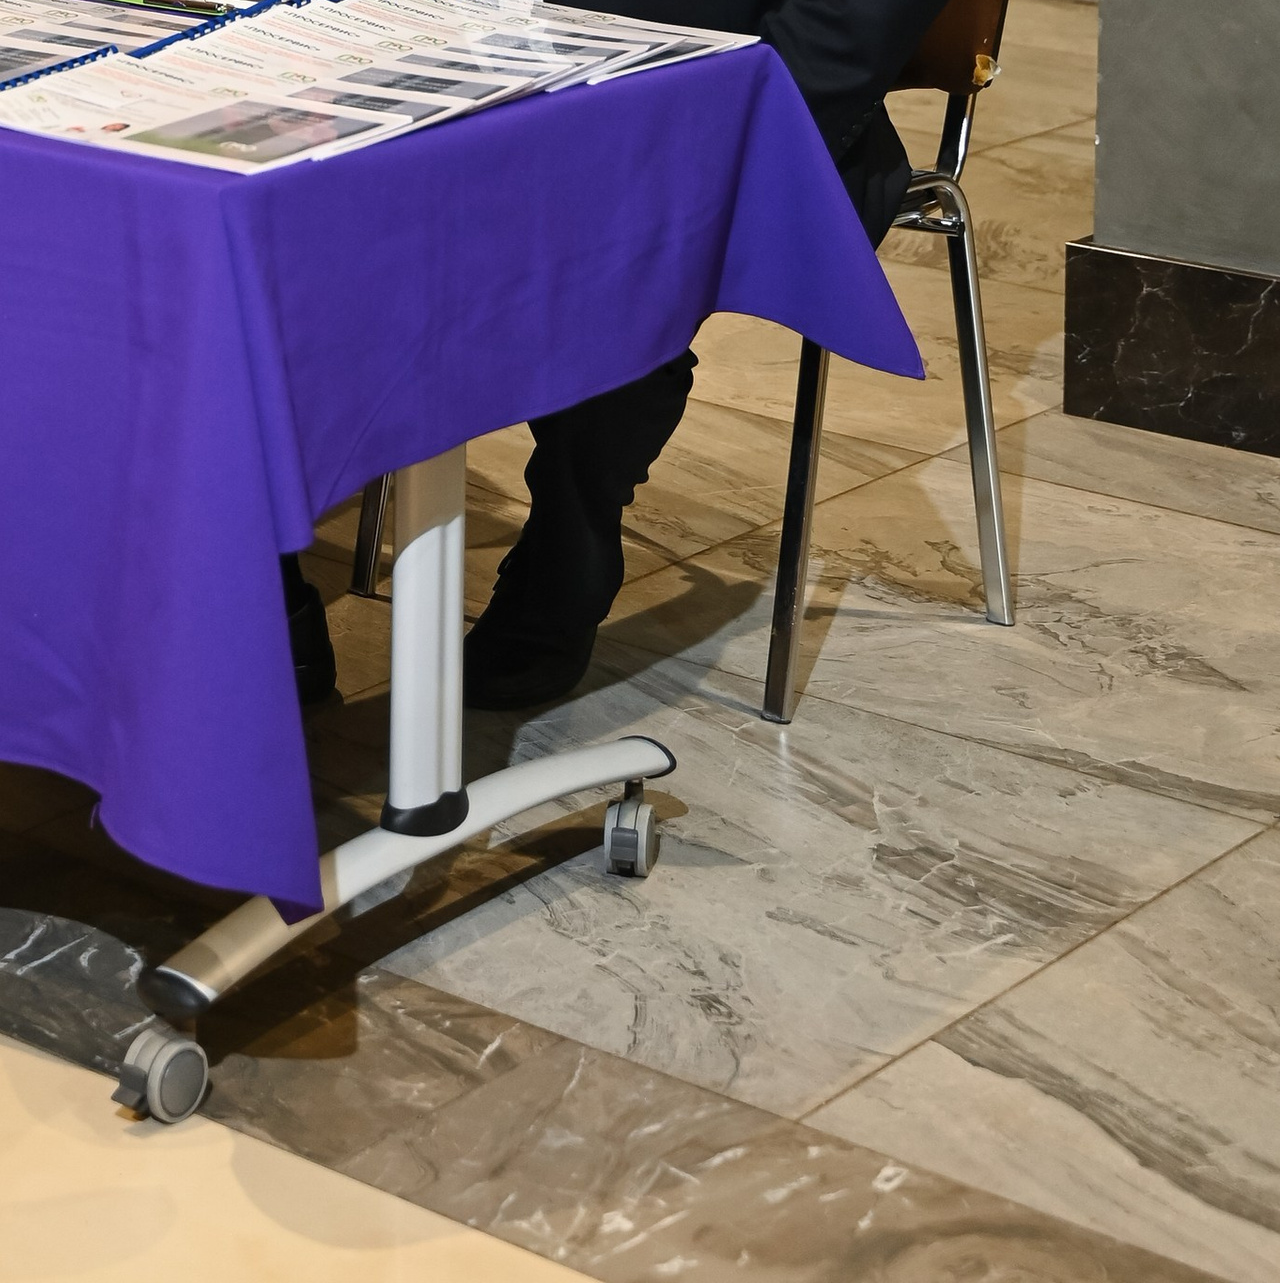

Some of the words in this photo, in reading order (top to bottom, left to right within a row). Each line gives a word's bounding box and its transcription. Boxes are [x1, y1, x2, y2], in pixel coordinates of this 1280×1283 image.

[283, 10, 361, 38] «ПРОСЕРВИС»
[320, 5, 396, 32] «ПРОСЕРВИС»
[243, 25, 320, 52] «ПРОСЕРВИС»
